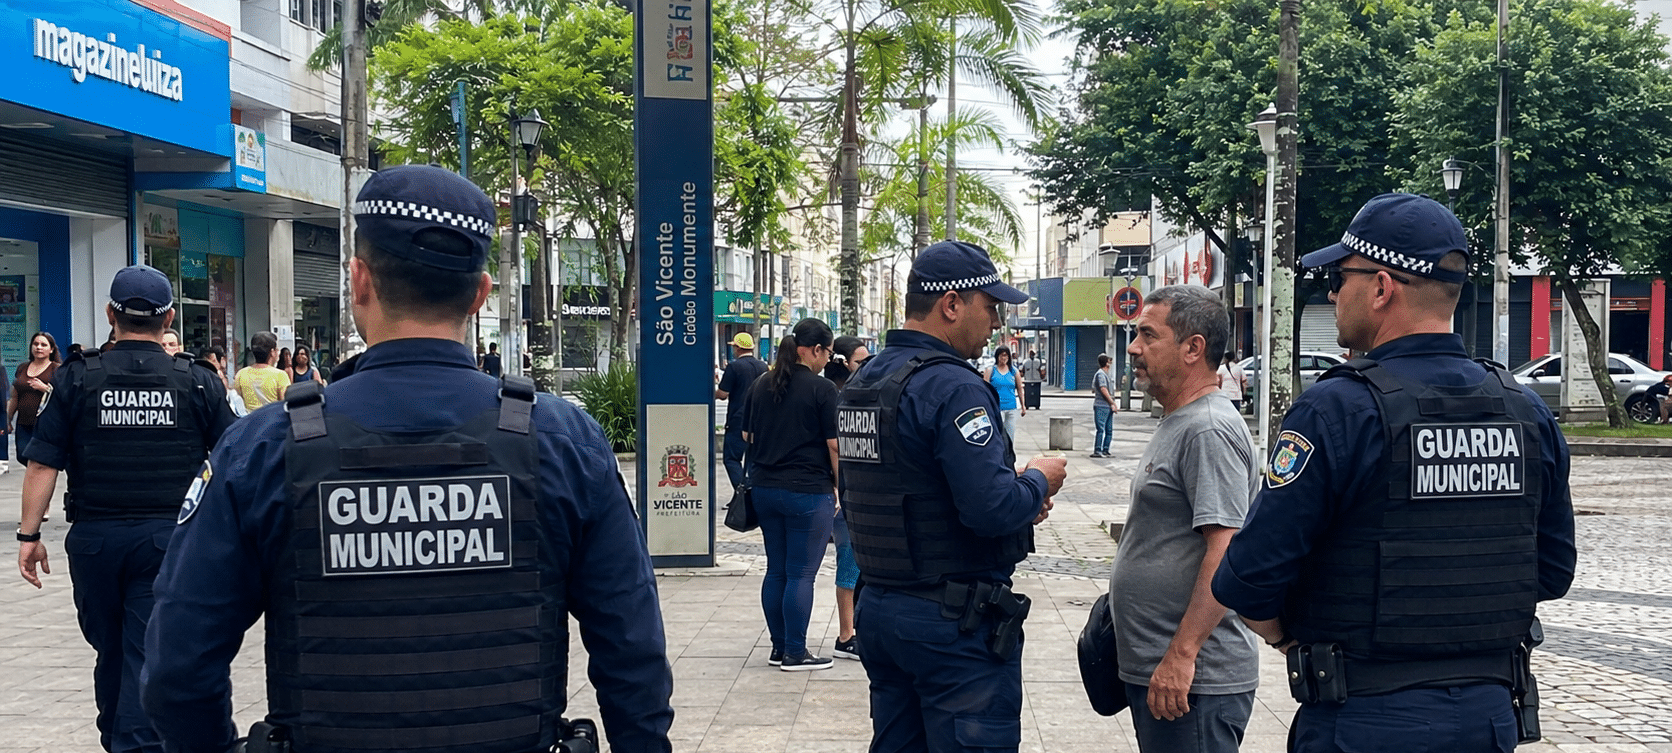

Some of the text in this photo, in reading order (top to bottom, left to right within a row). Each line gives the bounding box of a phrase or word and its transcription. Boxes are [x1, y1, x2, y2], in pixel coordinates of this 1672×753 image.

[33, 18, 183, 101] magazineluiza
[680, 181, 696, 296] Monumente
[655, 222, 674, 301] Vicente
[101, 390, 175, 407] GUARDA
[101, 409, 175, 426] MUNICIPAL
[838, 410, 877, 434] GUARDA
[838, 436, 878, 458] MUNICIPAL
[1417, 428, 1520, 459] GUARDA
[1416, 463, 1520, 493] MUNICIPAL
[328, 483, 503, 526] GUARDA
[653, 500, 702, 509] VICENTE
[329, 528, 504, 569] MUNICIPAL
